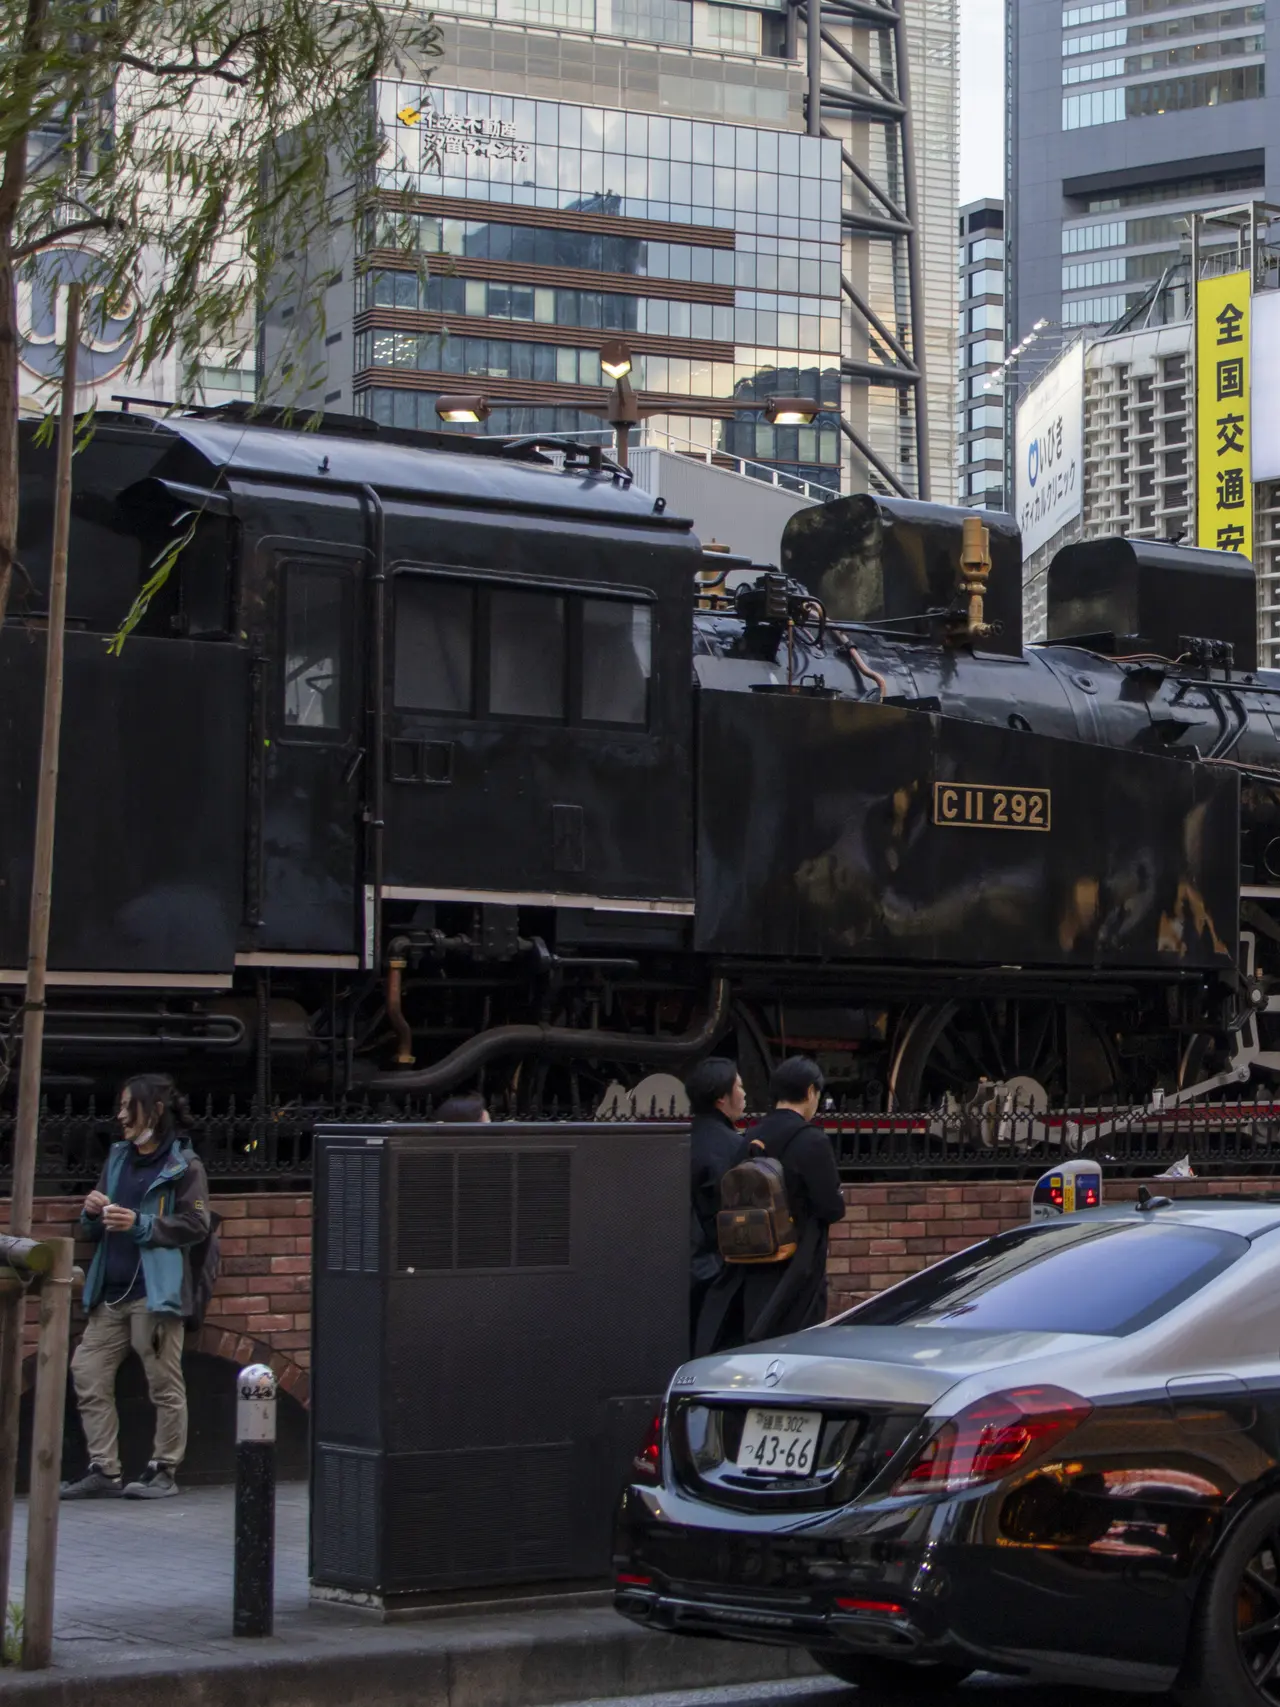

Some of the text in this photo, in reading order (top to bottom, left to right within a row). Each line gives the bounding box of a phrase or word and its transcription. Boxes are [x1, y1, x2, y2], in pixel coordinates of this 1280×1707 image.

[425, 110, 517, 139] 住友不動産
[993, 792, 1044, 824] 292
[783, 1415, 804, 1433] 302
[754, 1434, 813, 1469] 43-66
